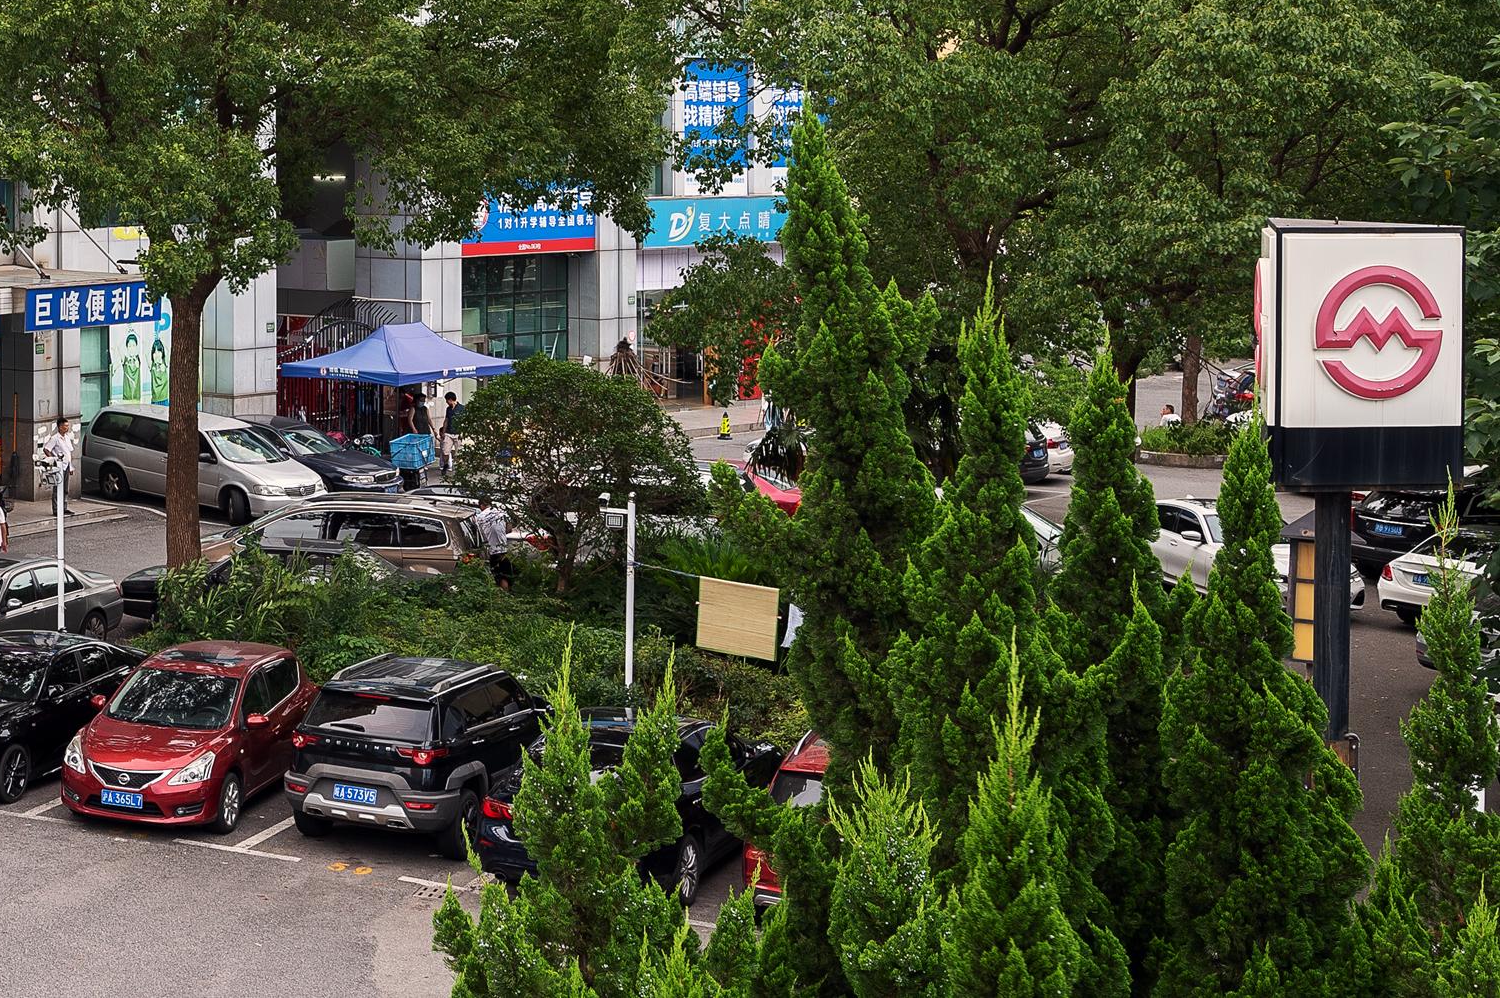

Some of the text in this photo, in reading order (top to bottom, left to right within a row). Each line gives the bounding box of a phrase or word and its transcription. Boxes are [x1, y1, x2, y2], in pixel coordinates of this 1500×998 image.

[35, 285, 154, 326] 巨峰便利店
